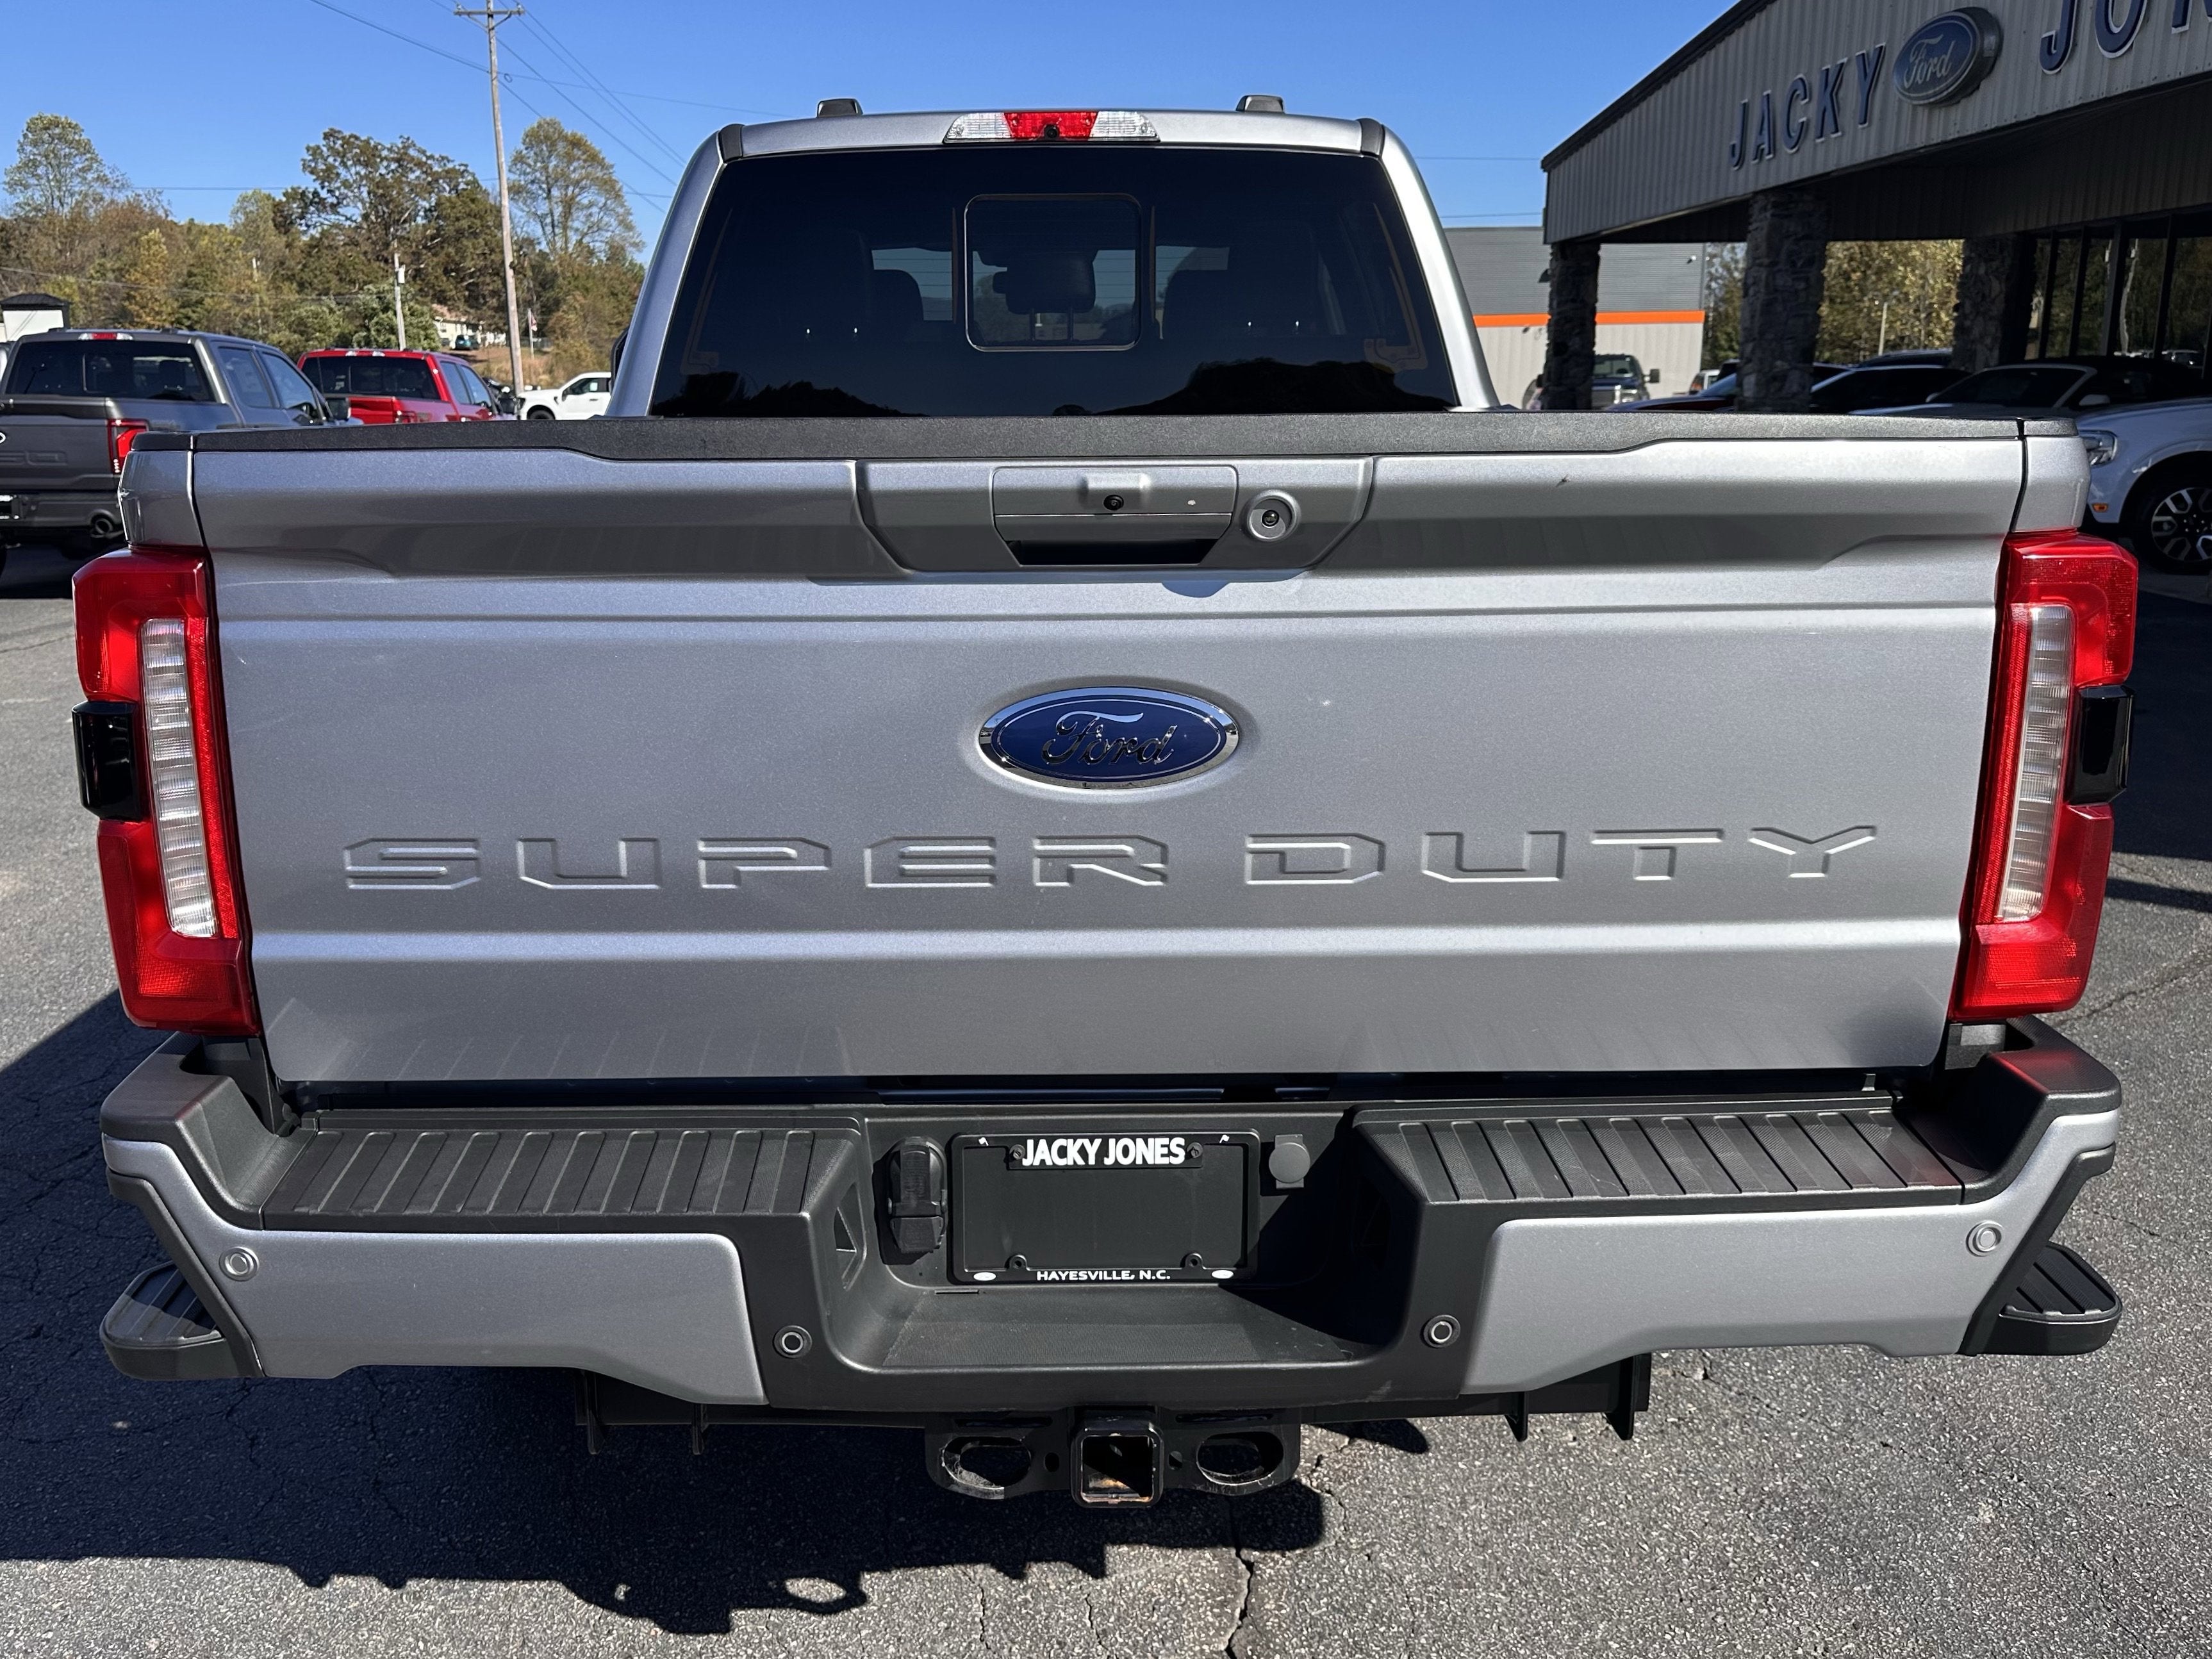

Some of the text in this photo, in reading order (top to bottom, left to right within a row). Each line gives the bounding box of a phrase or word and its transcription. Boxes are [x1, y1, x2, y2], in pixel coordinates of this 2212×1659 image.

[1729, 0, 2212, 170] JACKY Ford JO
[1042, 710, 1178, 765] Ford
[343, 825, 1878, 889] SUPER DUTY
[1022, 1137, 1185, 1166] JACKY JONES
[1036, 1269, 1171, 1281] HAYESVILLE, N.C.
